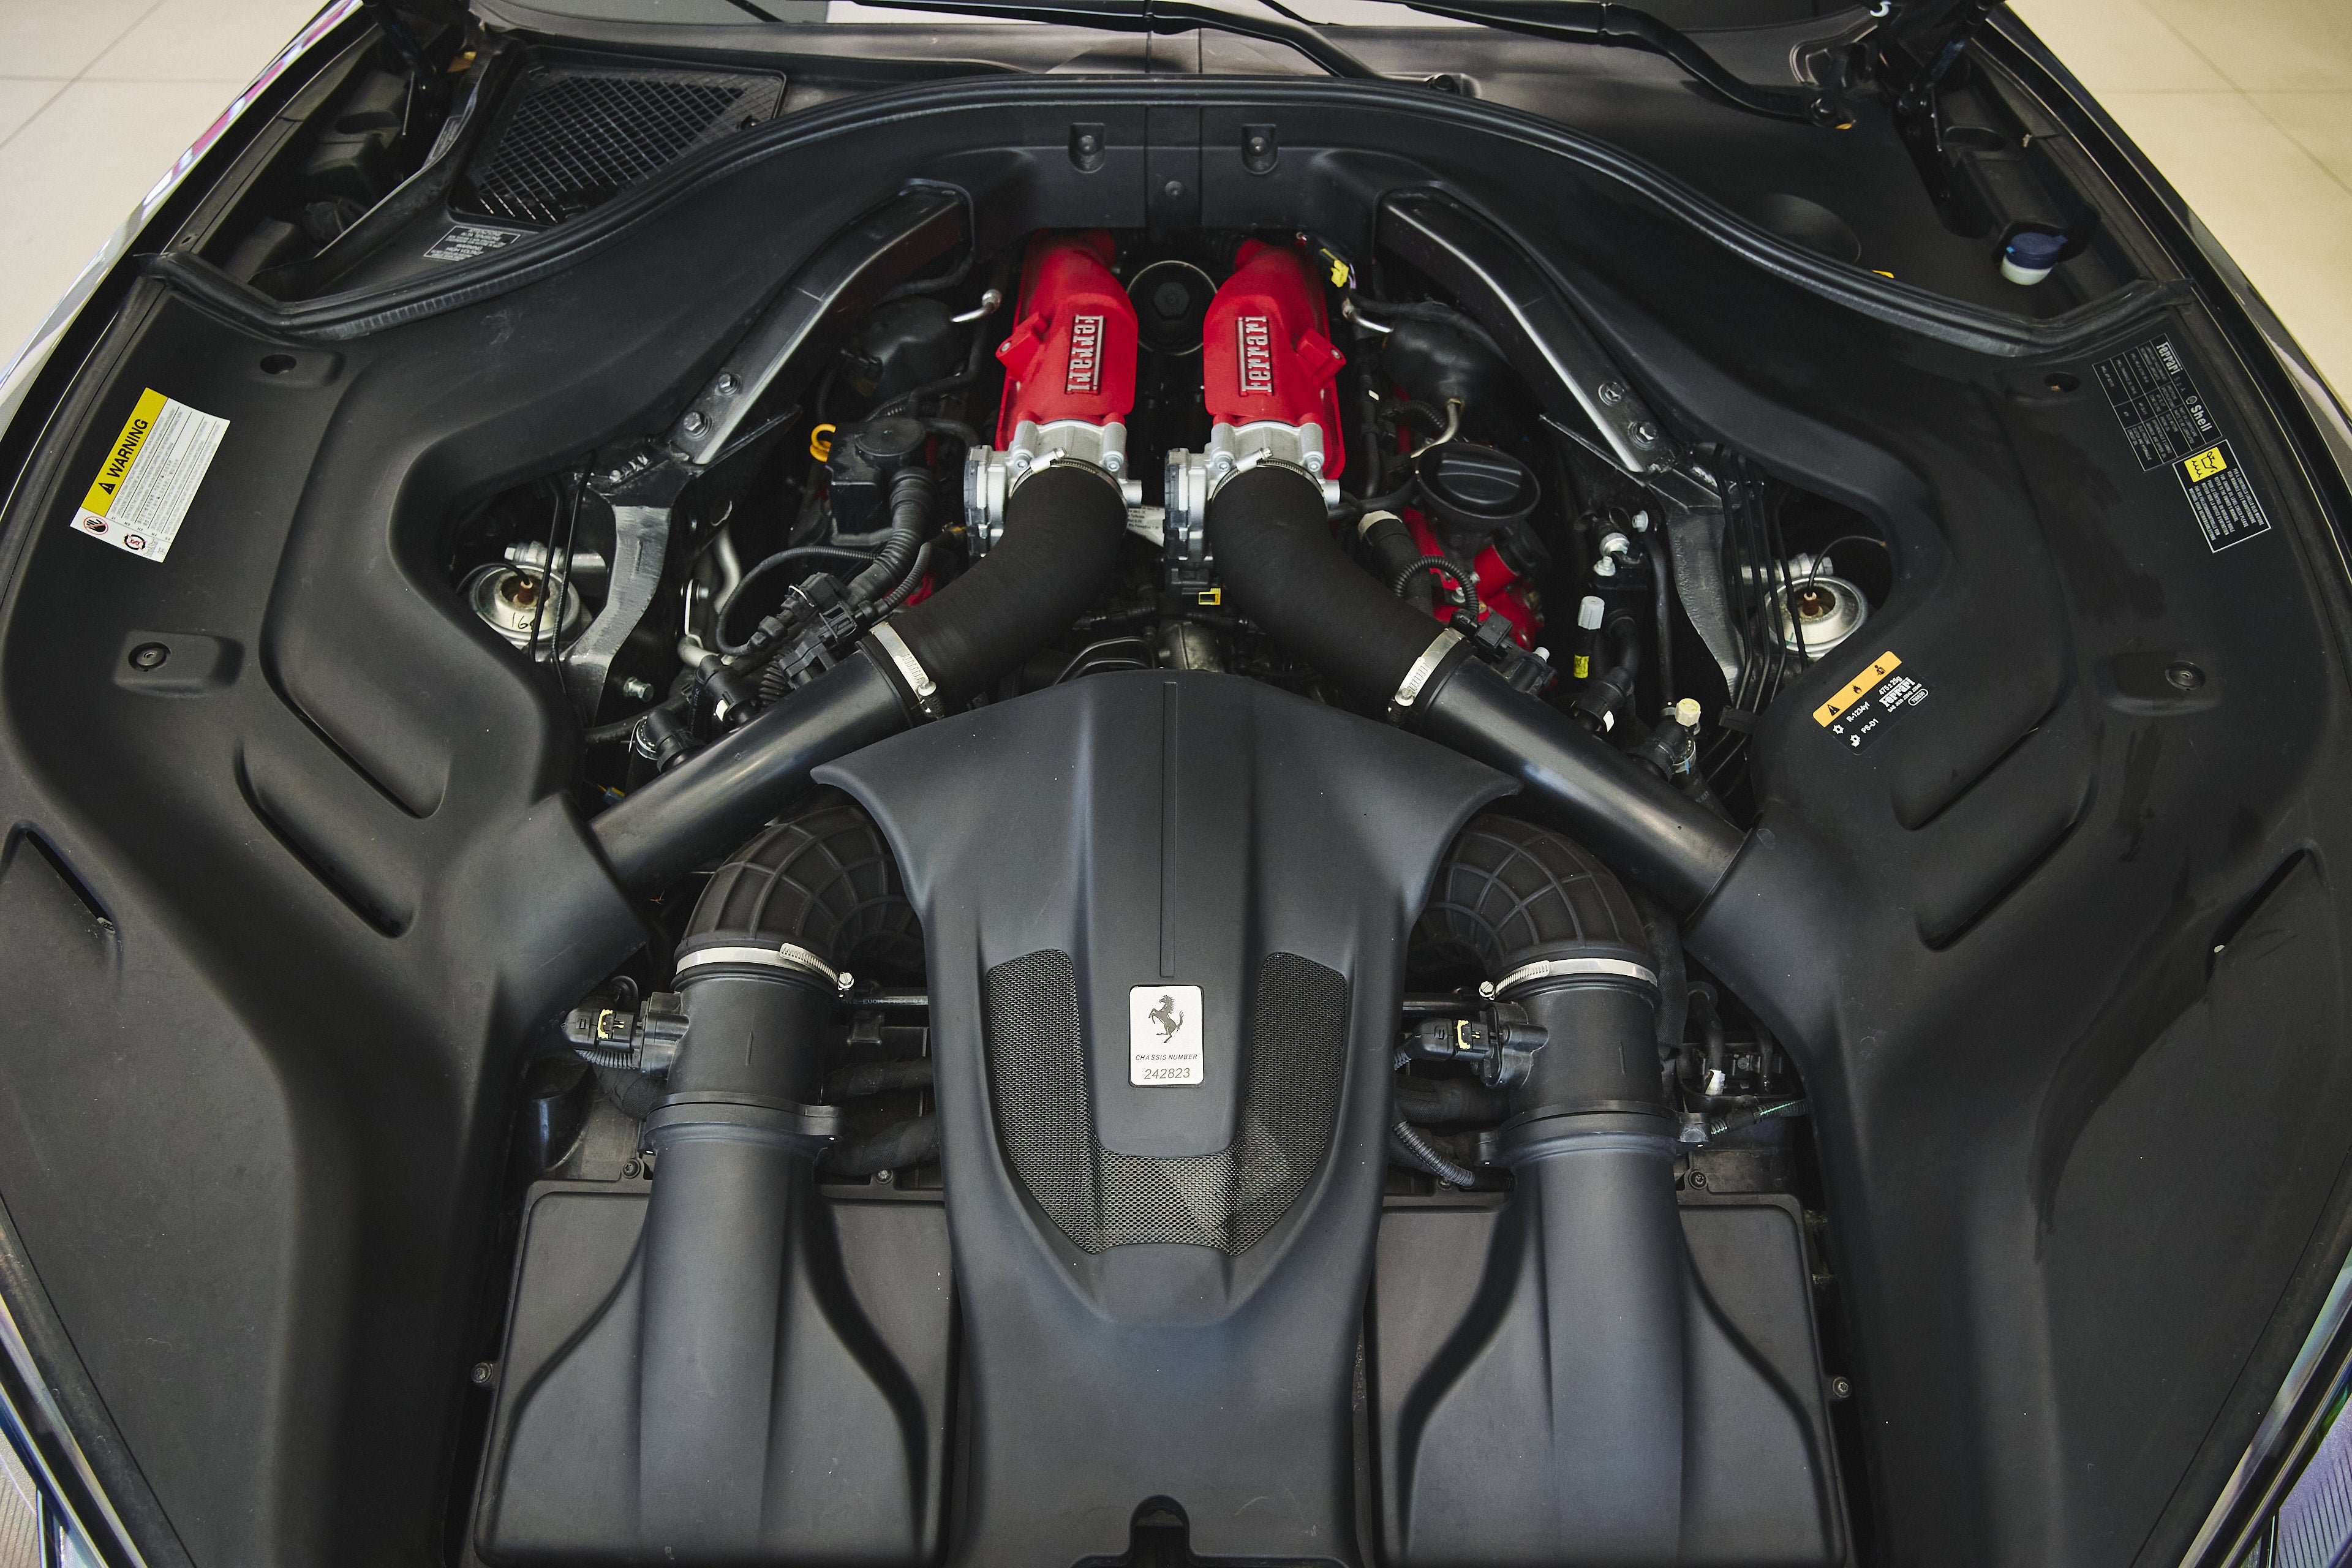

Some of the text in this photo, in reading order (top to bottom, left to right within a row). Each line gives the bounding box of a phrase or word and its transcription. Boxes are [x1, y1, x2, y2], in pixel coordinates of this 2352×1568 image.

[1068, 315, 1103, 392] Ferrari
[1239, 316, 1272, 393] Ferrari
[2156, 342, 2182, 374] Ferrari
[2190, 404, 2212, 431] Shell
[107, 418, 148, 478] WARNING
[511, 612, 533, 630] 16
[1879, 677, 1915, 707] Ferrari
[1861, 718, 1879, 733] PS-D1
[1144, 1068, 1190, 1079] 242823
